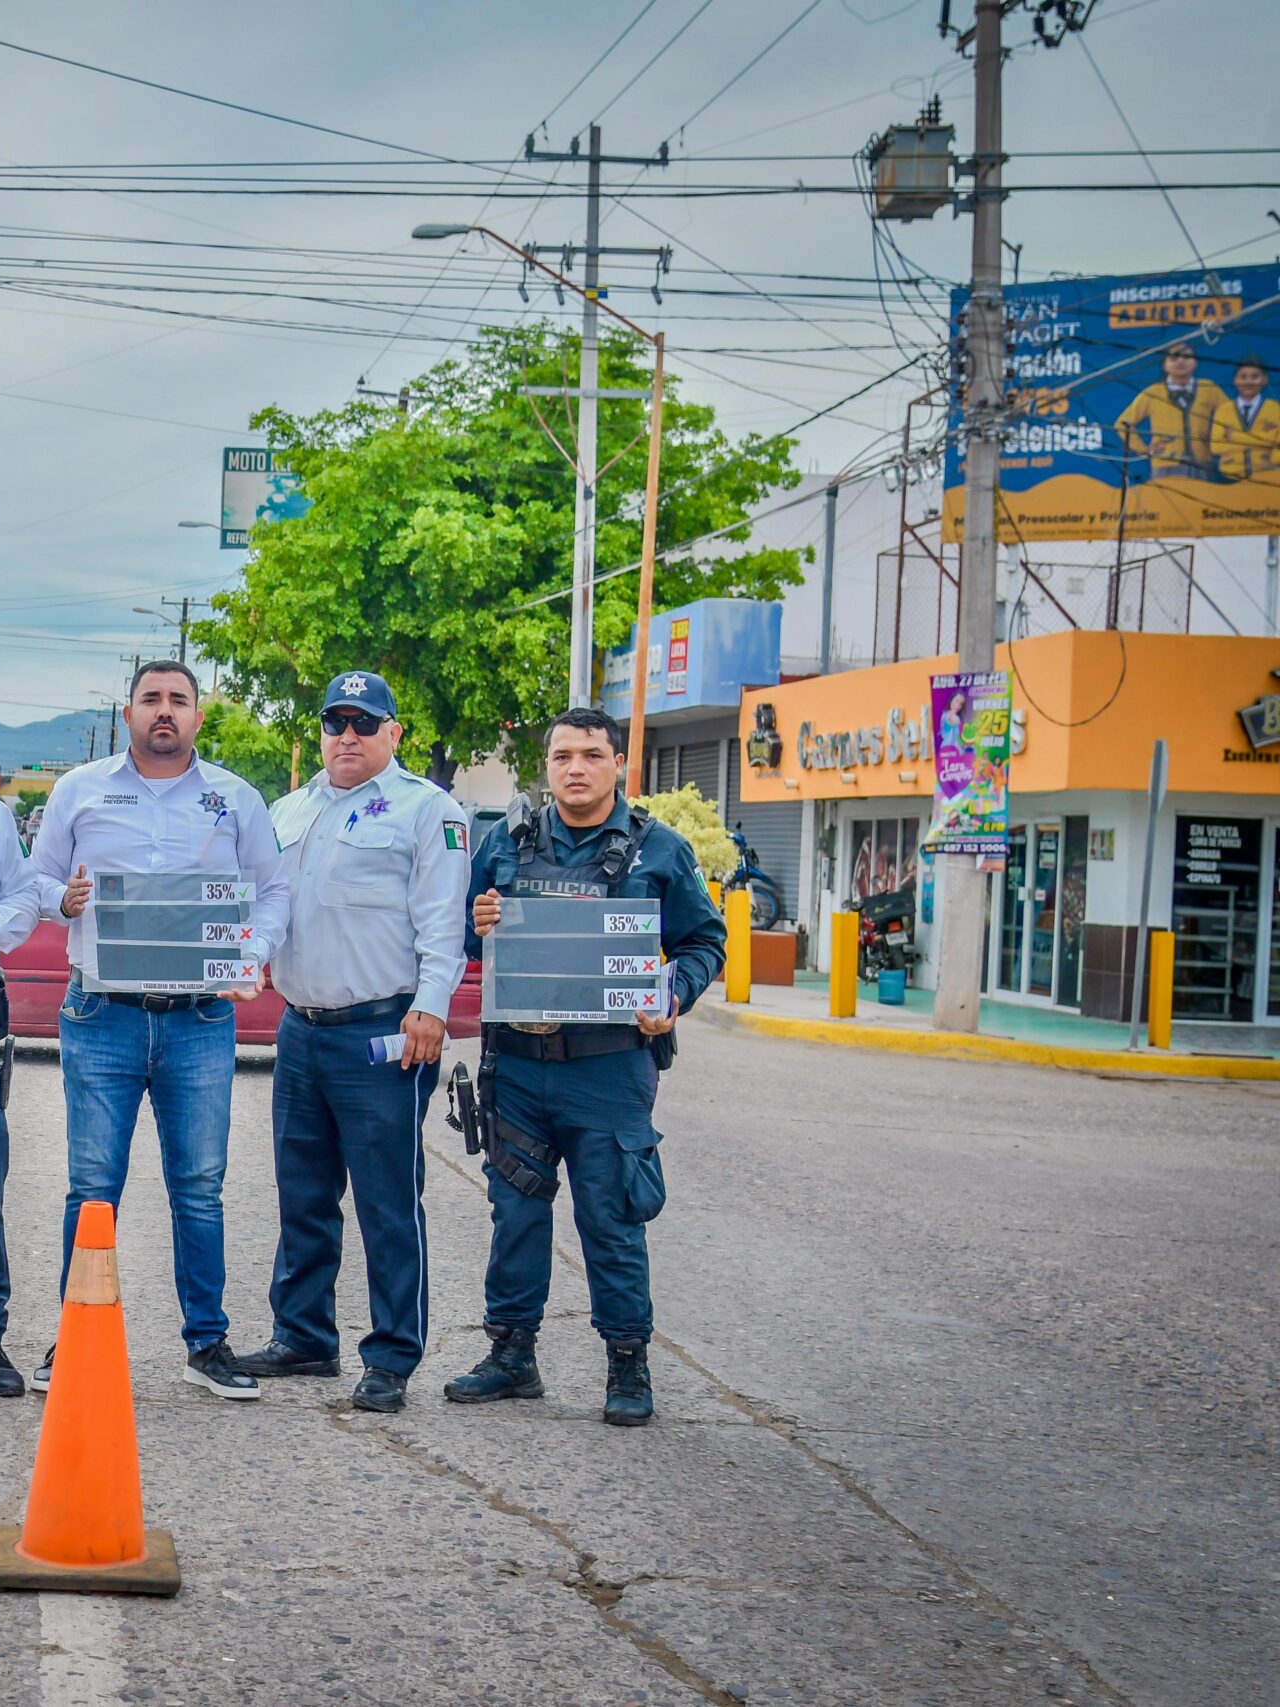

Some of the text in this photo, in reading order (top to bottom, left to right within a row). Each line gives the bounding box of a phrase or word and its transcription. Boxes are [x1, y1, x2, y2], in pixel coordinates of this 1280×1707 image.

[1110, 280, 1243, 304] INSCRIPCIOES
[1117, 301, 1232, 323] ABIERTAS
[228, 451, 266, 471] MOTO
[1018, 514, 1084, 525] Preescolar
[973, 699, 1009, 710] VIERNES
[980, 709, 1009, 735] 25
[797, 721, 884, 770] Carnes
[981, 736, 1005, 747] JULIO
[1206, 825, 1240, 838] VENTA
[206, 883, 235, 900] 35%
[516, 880, 601, 897] POLICIA
[609, 916, 639, 932] 35%
[206, 925, 235, 942] 20%
[207, 962, 237, 979] 05%
[608, 958, 638, 974] 20%
[608, 991, 638, 1008] 05%
